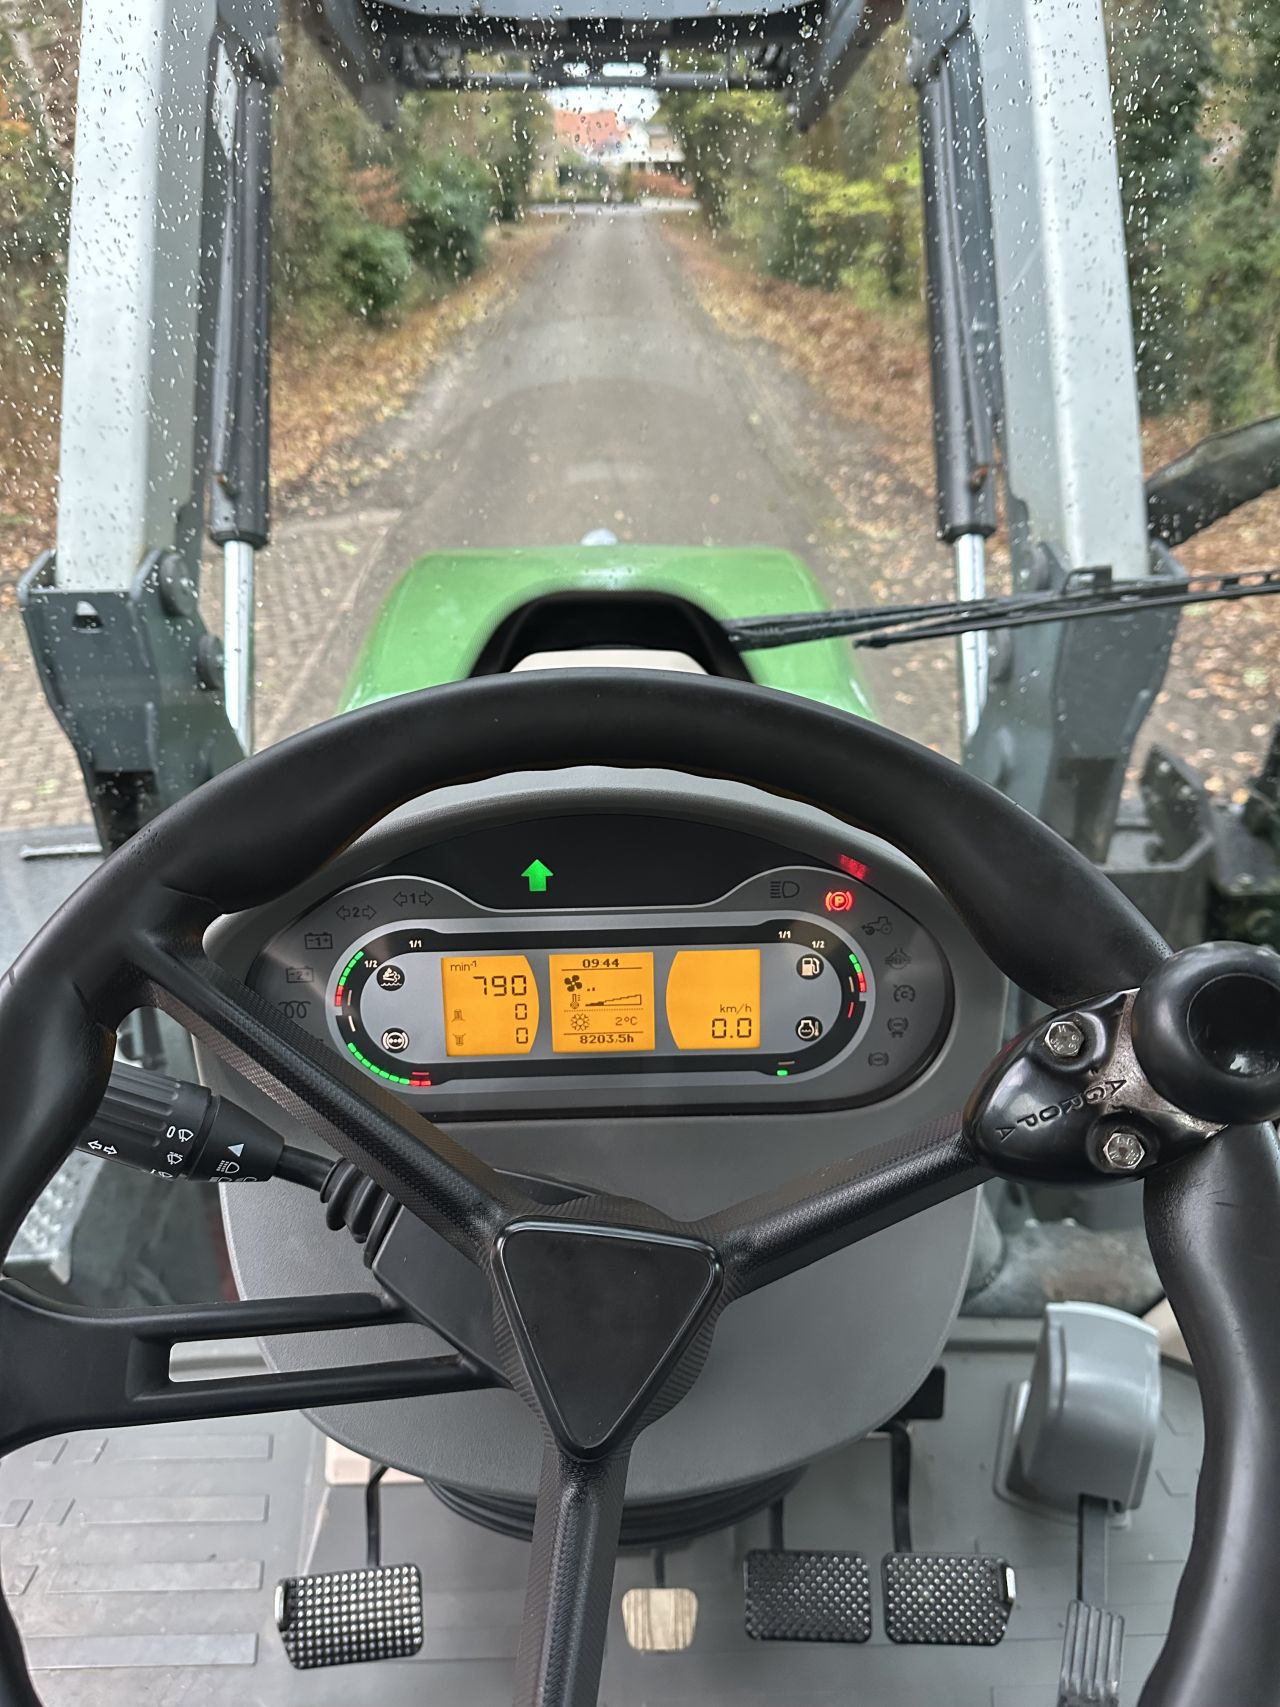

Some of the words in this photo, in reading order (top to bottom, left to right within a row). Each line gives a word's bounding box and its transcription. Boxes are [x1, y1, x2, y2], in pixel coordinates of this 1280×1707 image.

[778, 931, 791, 939] 1/1
[408, 940, 422, 948] 1/1
[364, 960, 378, 968] 1/2
[473, 975, 527, 997] 790
[515, 1003, 528, 1020] 0
[719, 1003, 752, 1014] km/h
[516, 1027, 529, 1044] 0
[712, 1018, 752, 1038] 0.0
[995, 1078, 1127, 1144] AGROPA
